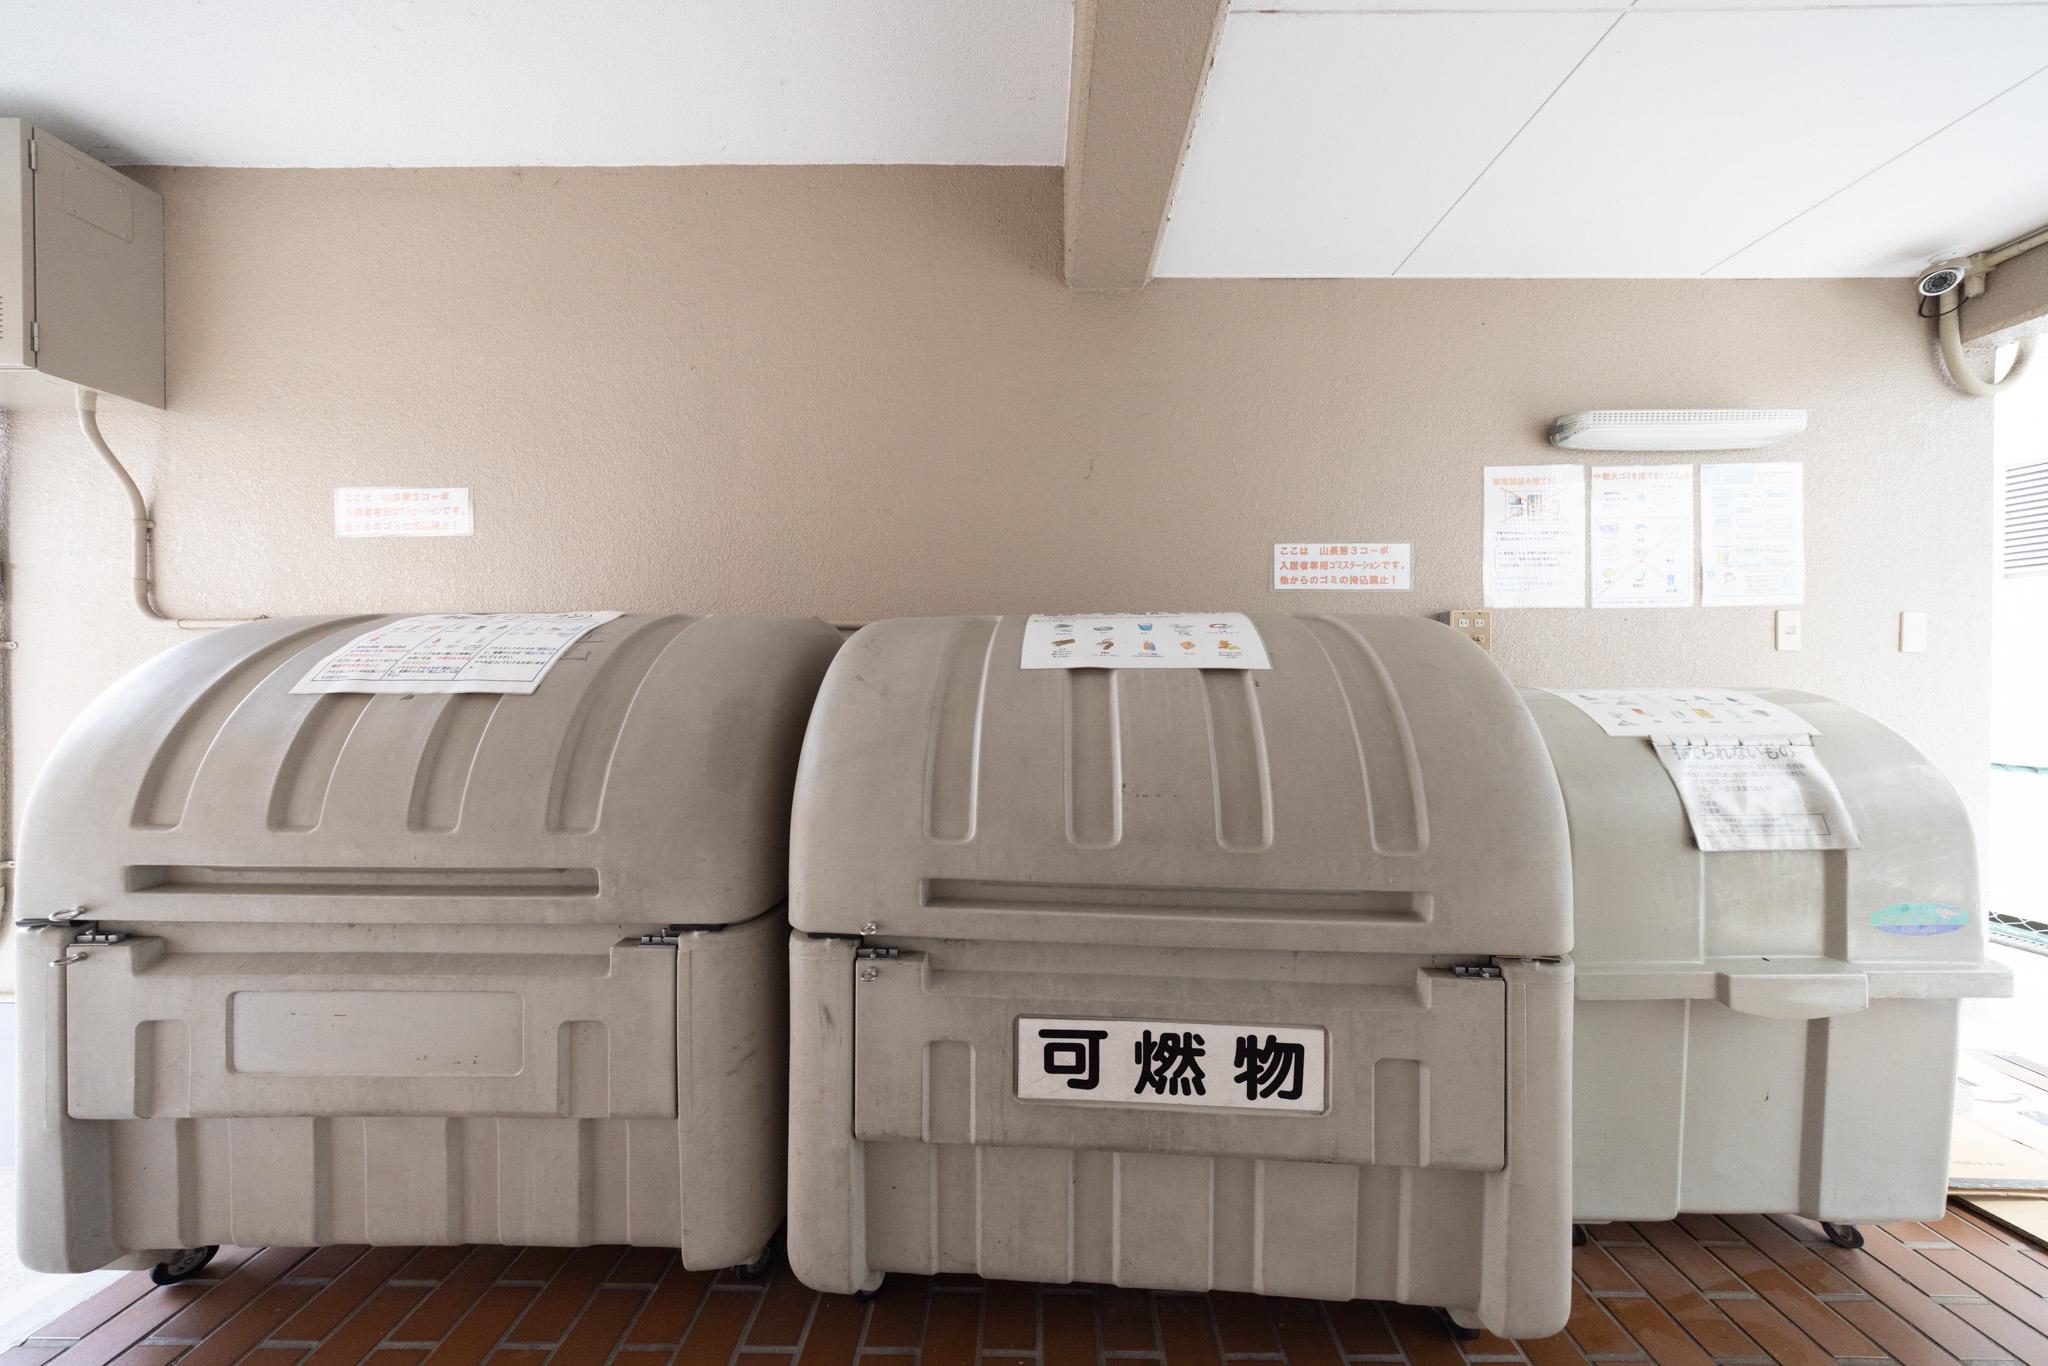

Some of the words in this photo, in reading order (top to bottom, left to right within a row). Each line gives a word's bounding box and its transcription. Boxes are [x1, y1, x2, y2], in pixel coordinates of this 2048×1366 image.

[1280, 546, 1309, 556] ここは
[1038, 1028, 1305, 1101] 可燃物
